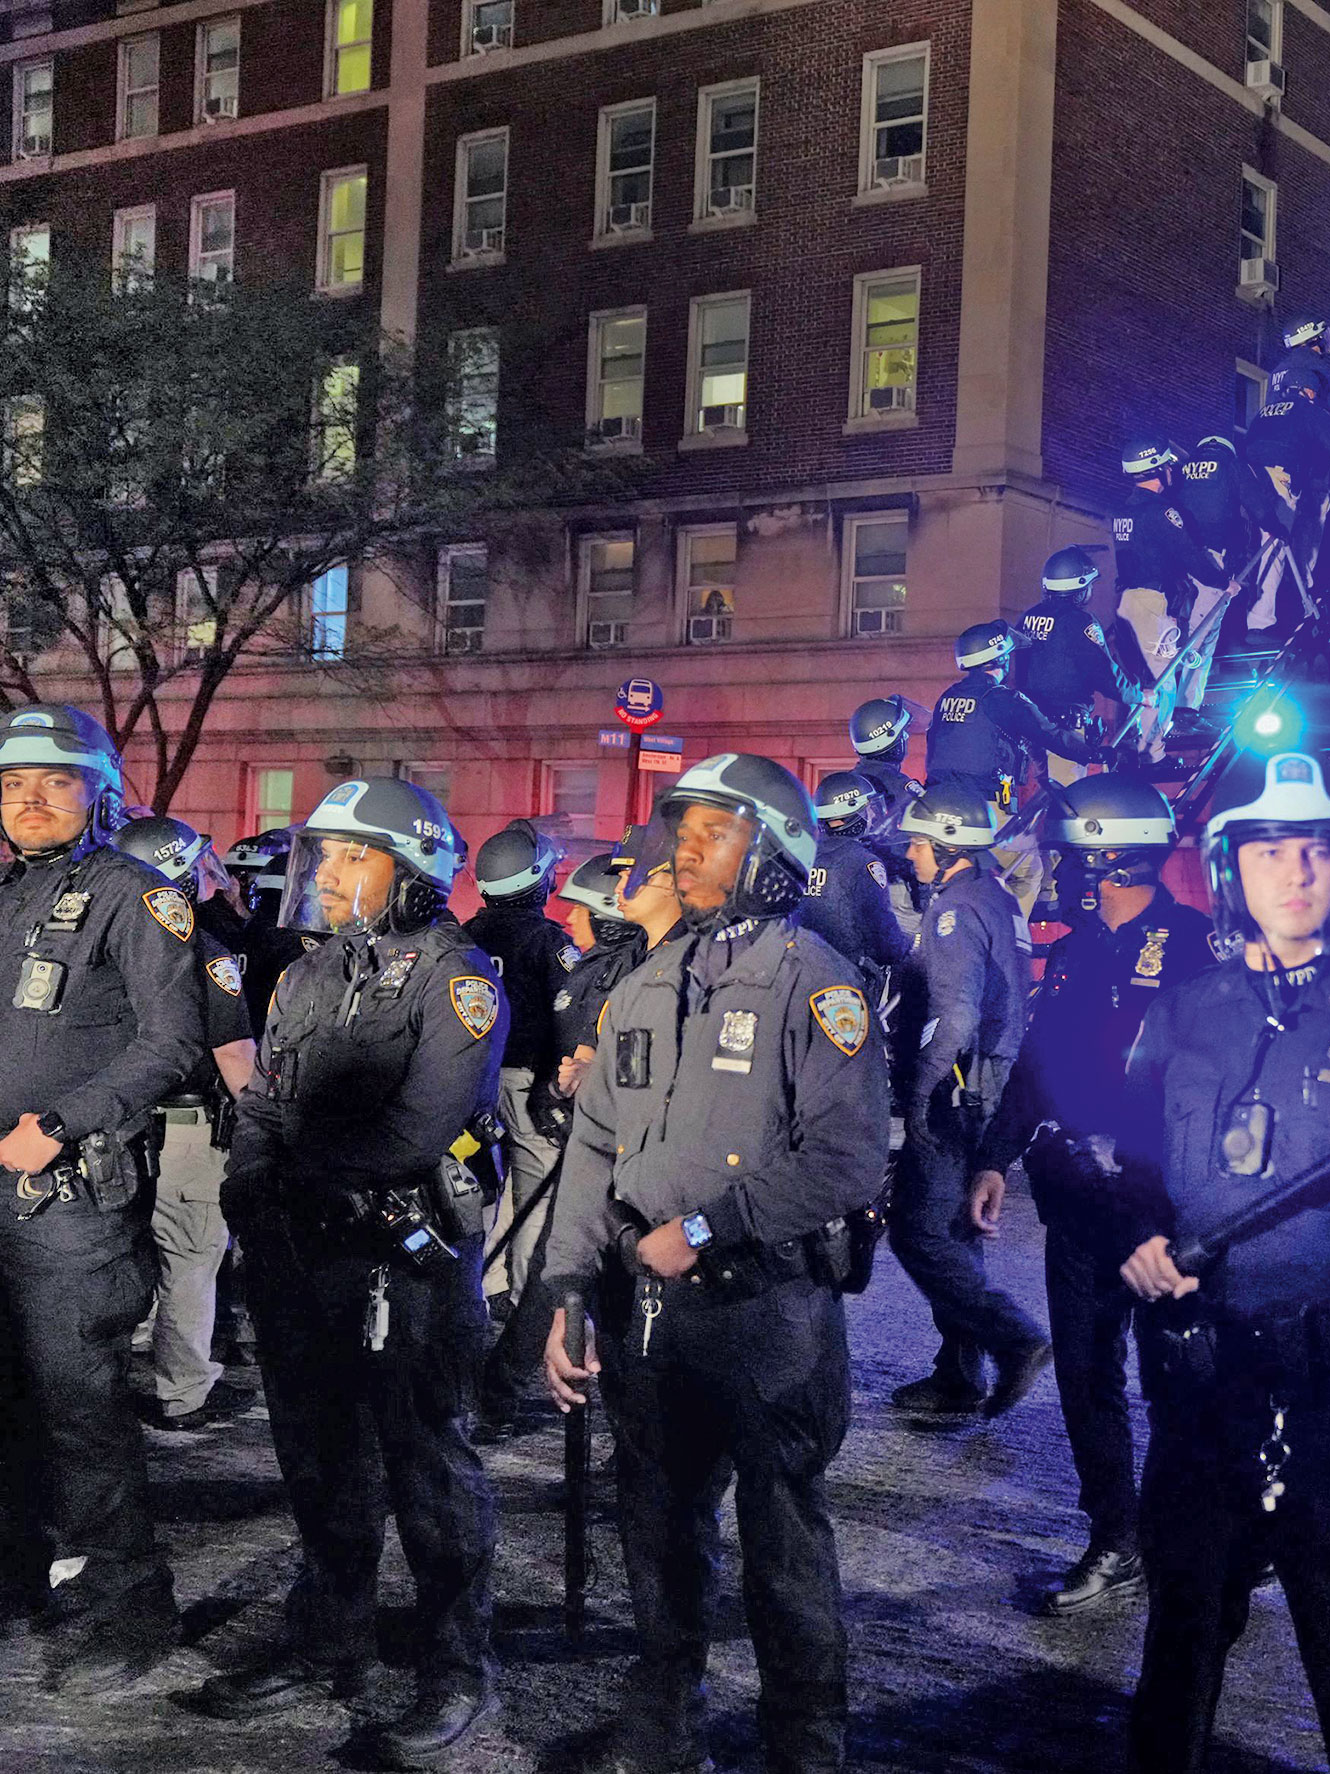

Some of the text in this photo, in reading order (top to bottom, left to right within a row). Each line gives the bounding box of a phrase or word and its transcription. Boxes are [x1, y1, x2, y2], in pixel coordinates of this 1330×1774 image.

[1182, 461, 1218, 475] NYPD
[1185, 472, 1210, 480] POLICE
[1113, 518, 1134, 533] NYPD
[1115, 533, 1130, 541] POLICE
[1022, 615, 1055, 633] NYPD
[939, 697, 976, 714] NYPD
[616, 708, 660, 725] NO STANDING
[941, 712, 966, 723] POLICE
[868, 720, 893, 740] 10219
[599, 733, 625, 746] M11
[832, 789, 860, 804] 27870
[153, 837, 187, 862] 15724
[807, 868, 827, 887] PD
